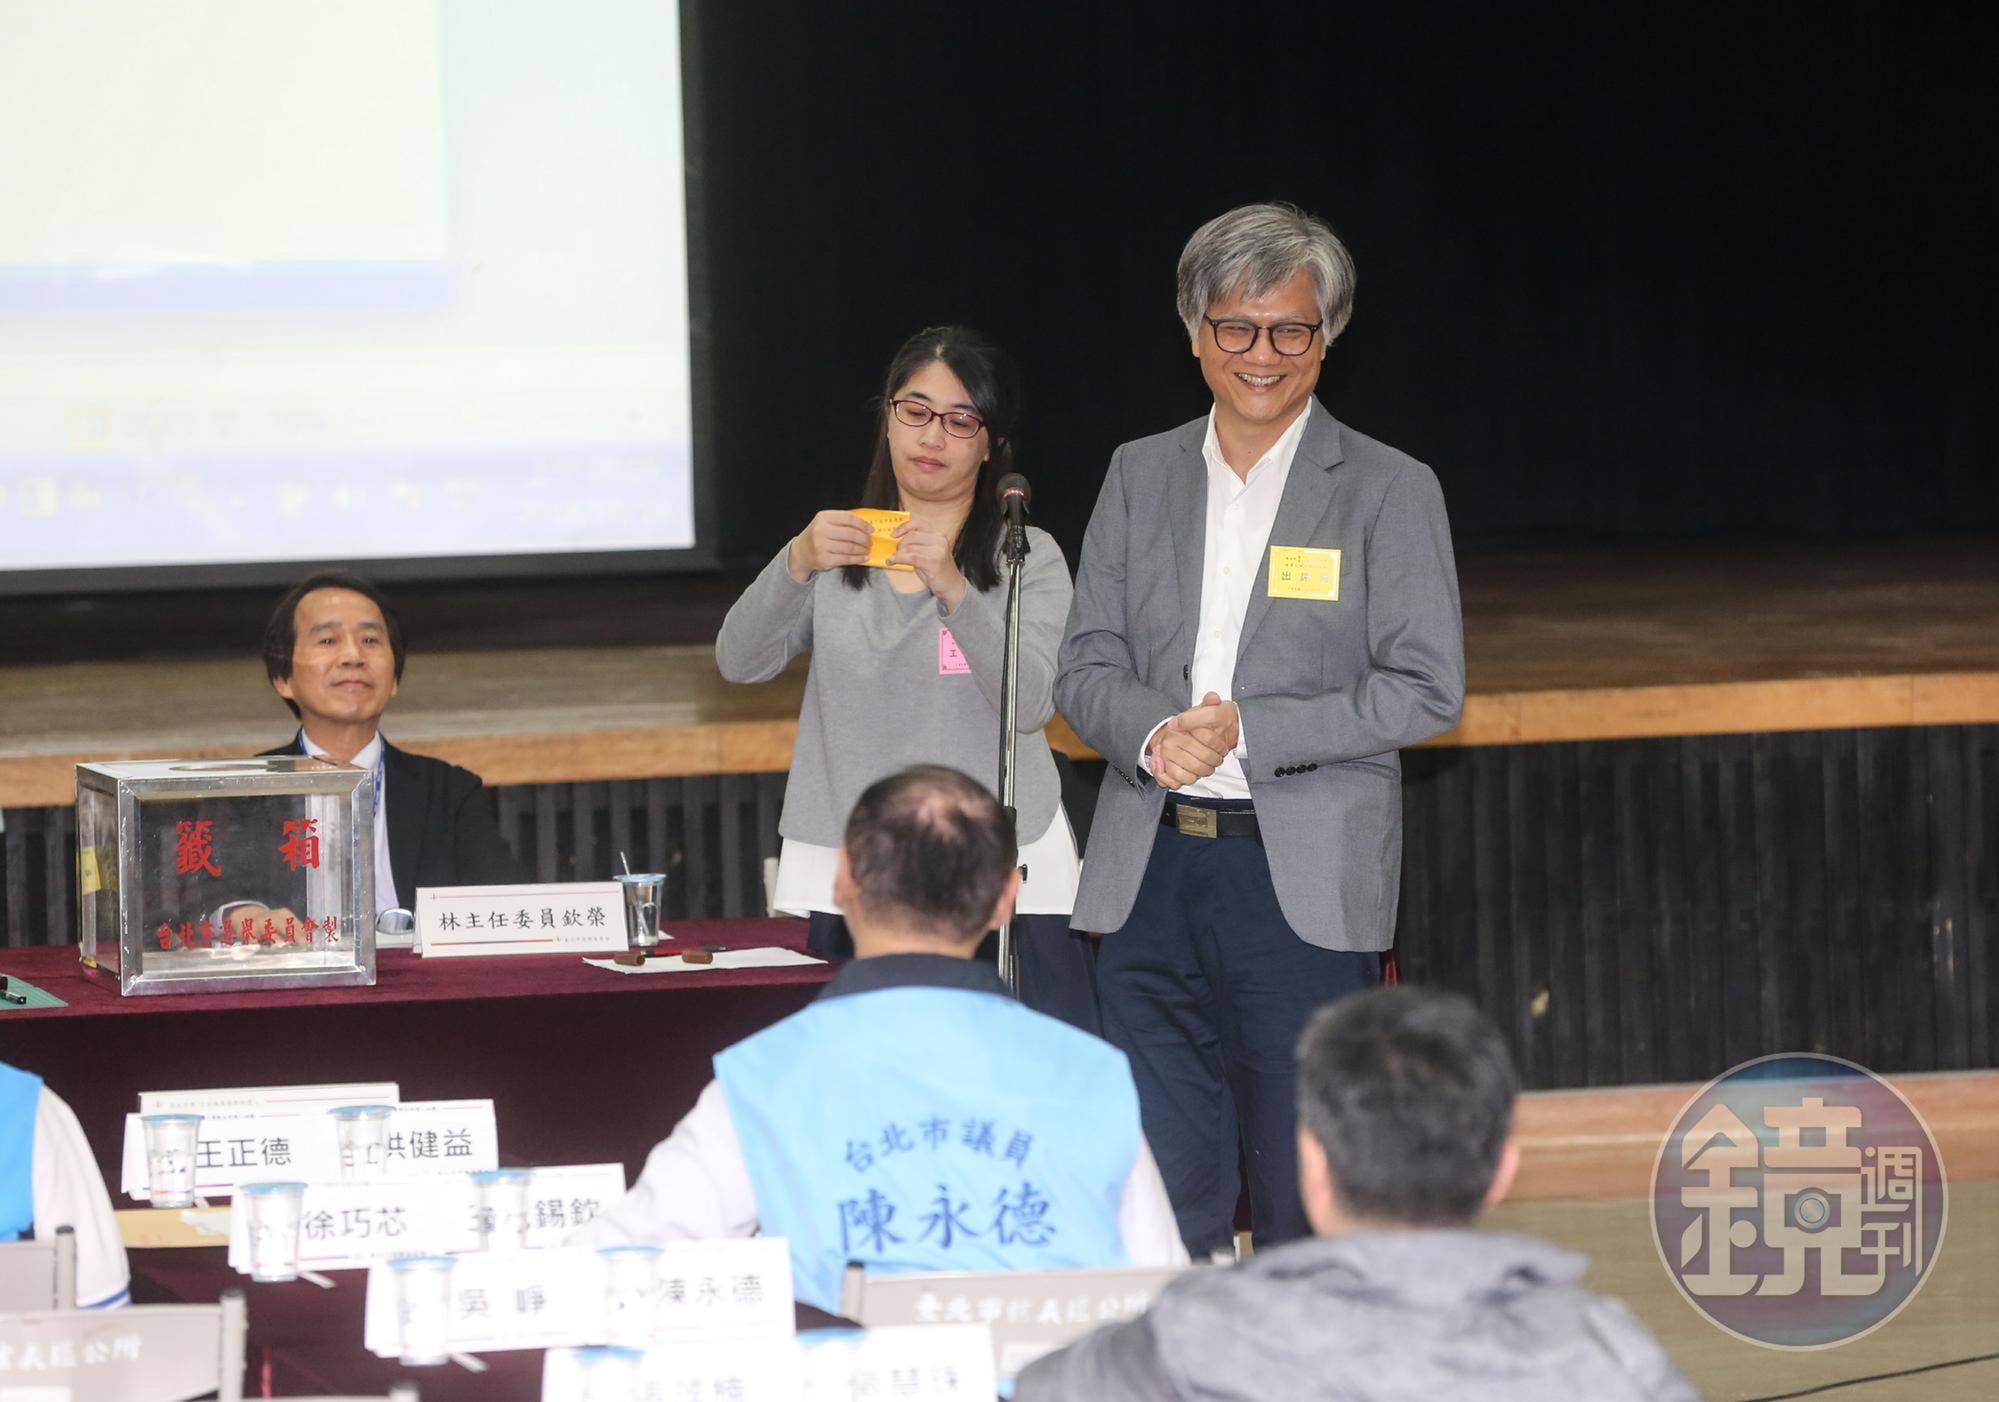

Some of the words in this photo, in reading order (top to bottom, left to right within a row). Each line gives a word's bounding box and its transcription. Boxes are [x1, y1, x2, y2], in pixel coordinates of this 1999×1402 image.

[155, 915, 340, 950] 台北市選舉委員會製
[438, 907, 607, 931] 林主任委員欽榮
[196, 1137, 292, 1169] 王正德
[845, 1116, 1034, 1173] 台北市議員
[303, 1207, 407, 1241] 徐巧芯
[518, 1197, 600, 1230] 錫欽
[837, 1181, 1057, 1254] 陳永德
